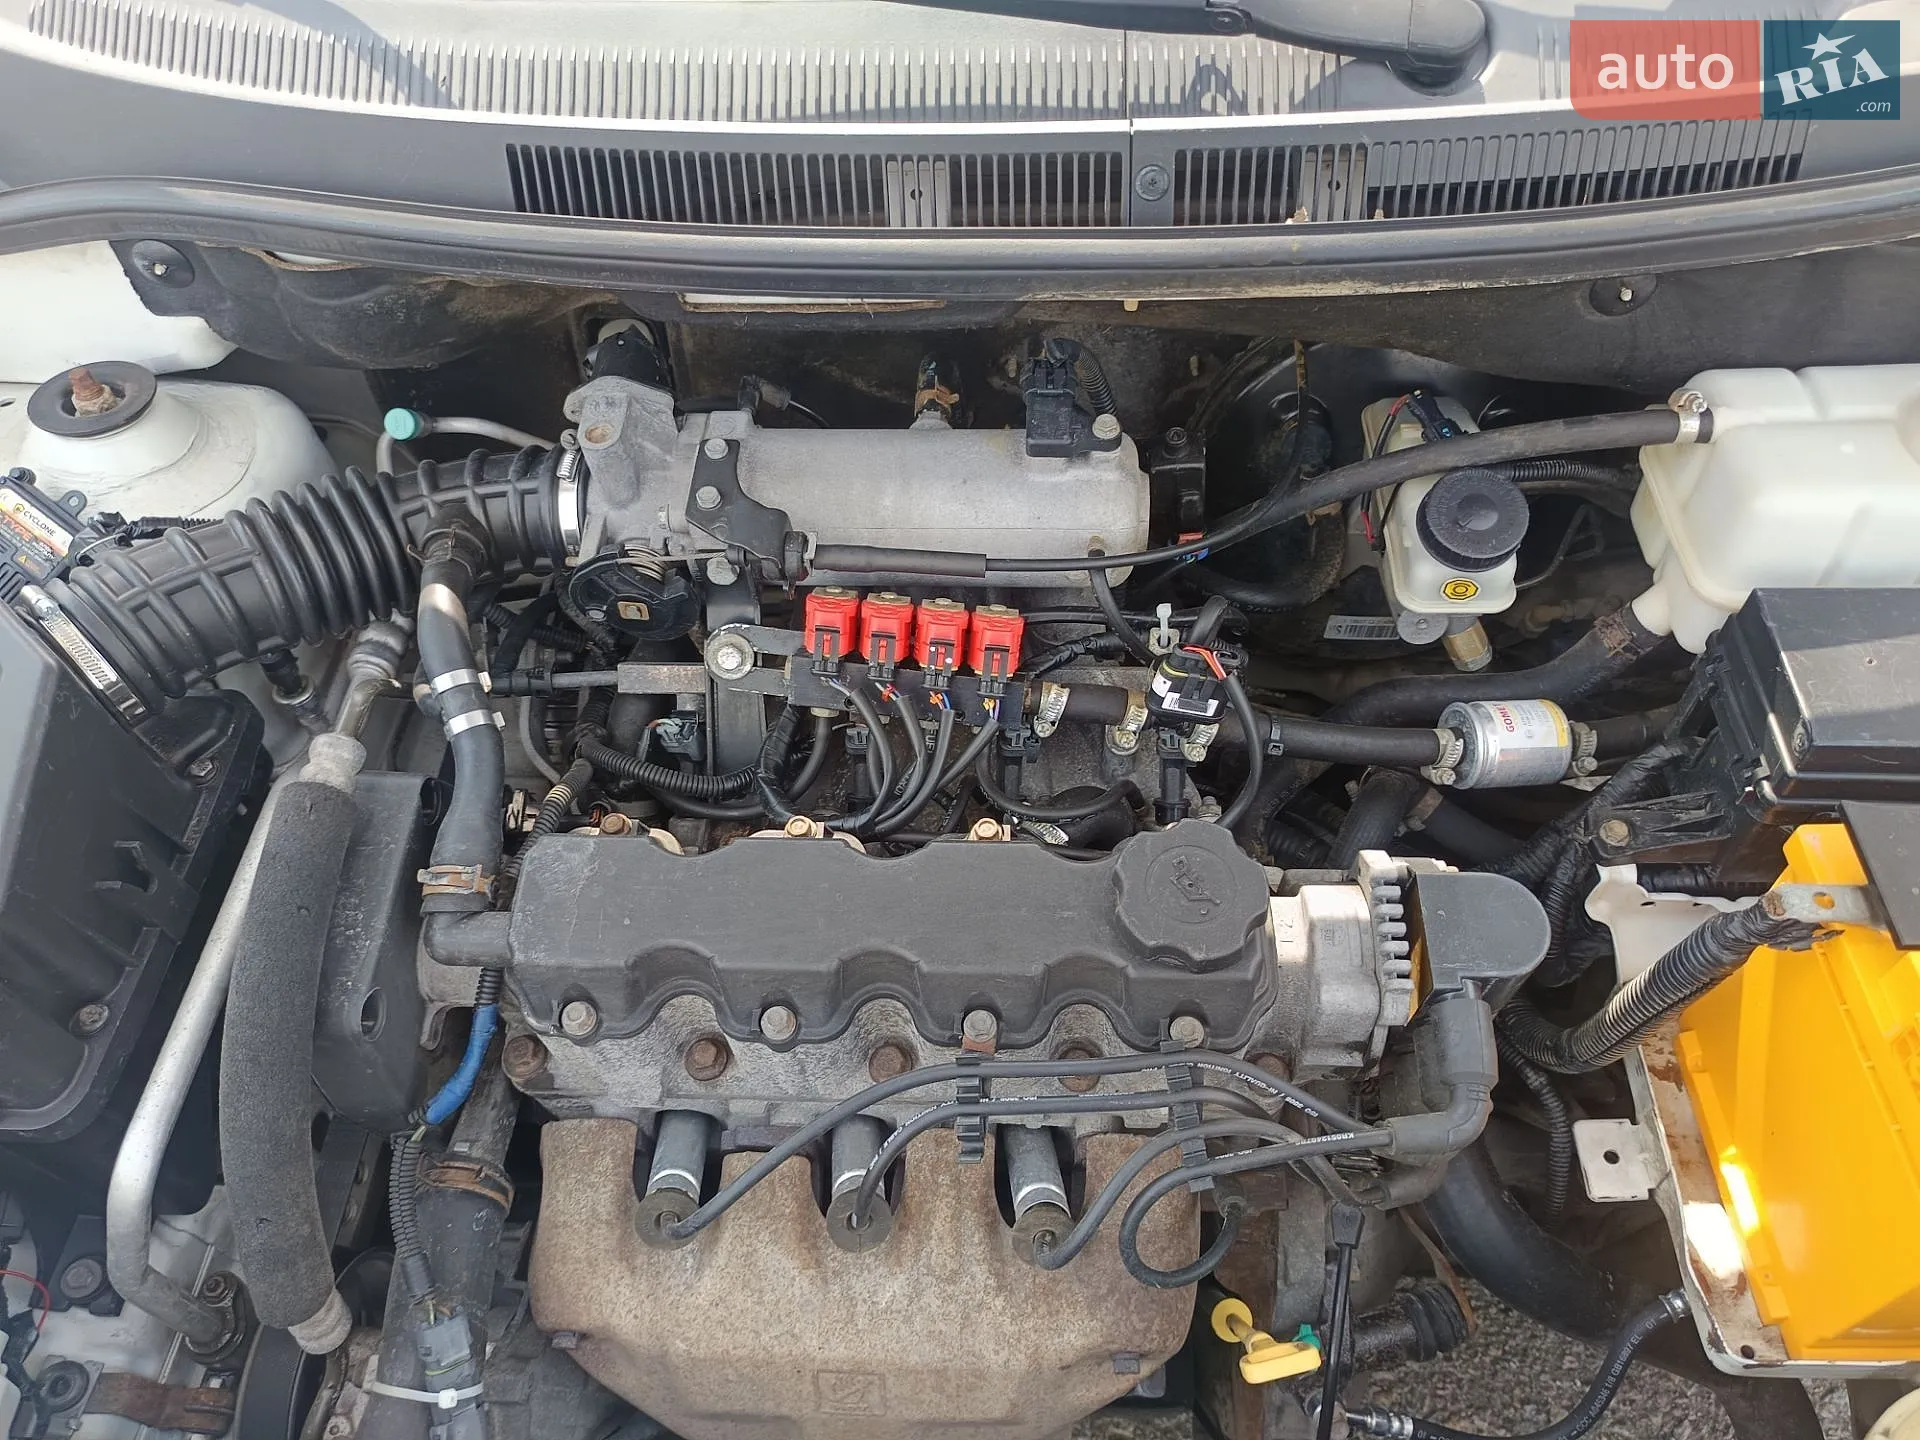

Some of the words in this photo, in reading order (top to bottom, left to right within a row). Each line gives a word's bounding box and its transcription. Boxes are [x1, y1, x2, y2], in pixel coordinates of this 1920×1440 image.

[23, 510, 57, 537] CYCLONE
[1196, 1062, 1232, 1074] IGNITION
[1304, 1107, 1319, 1118] ISO
